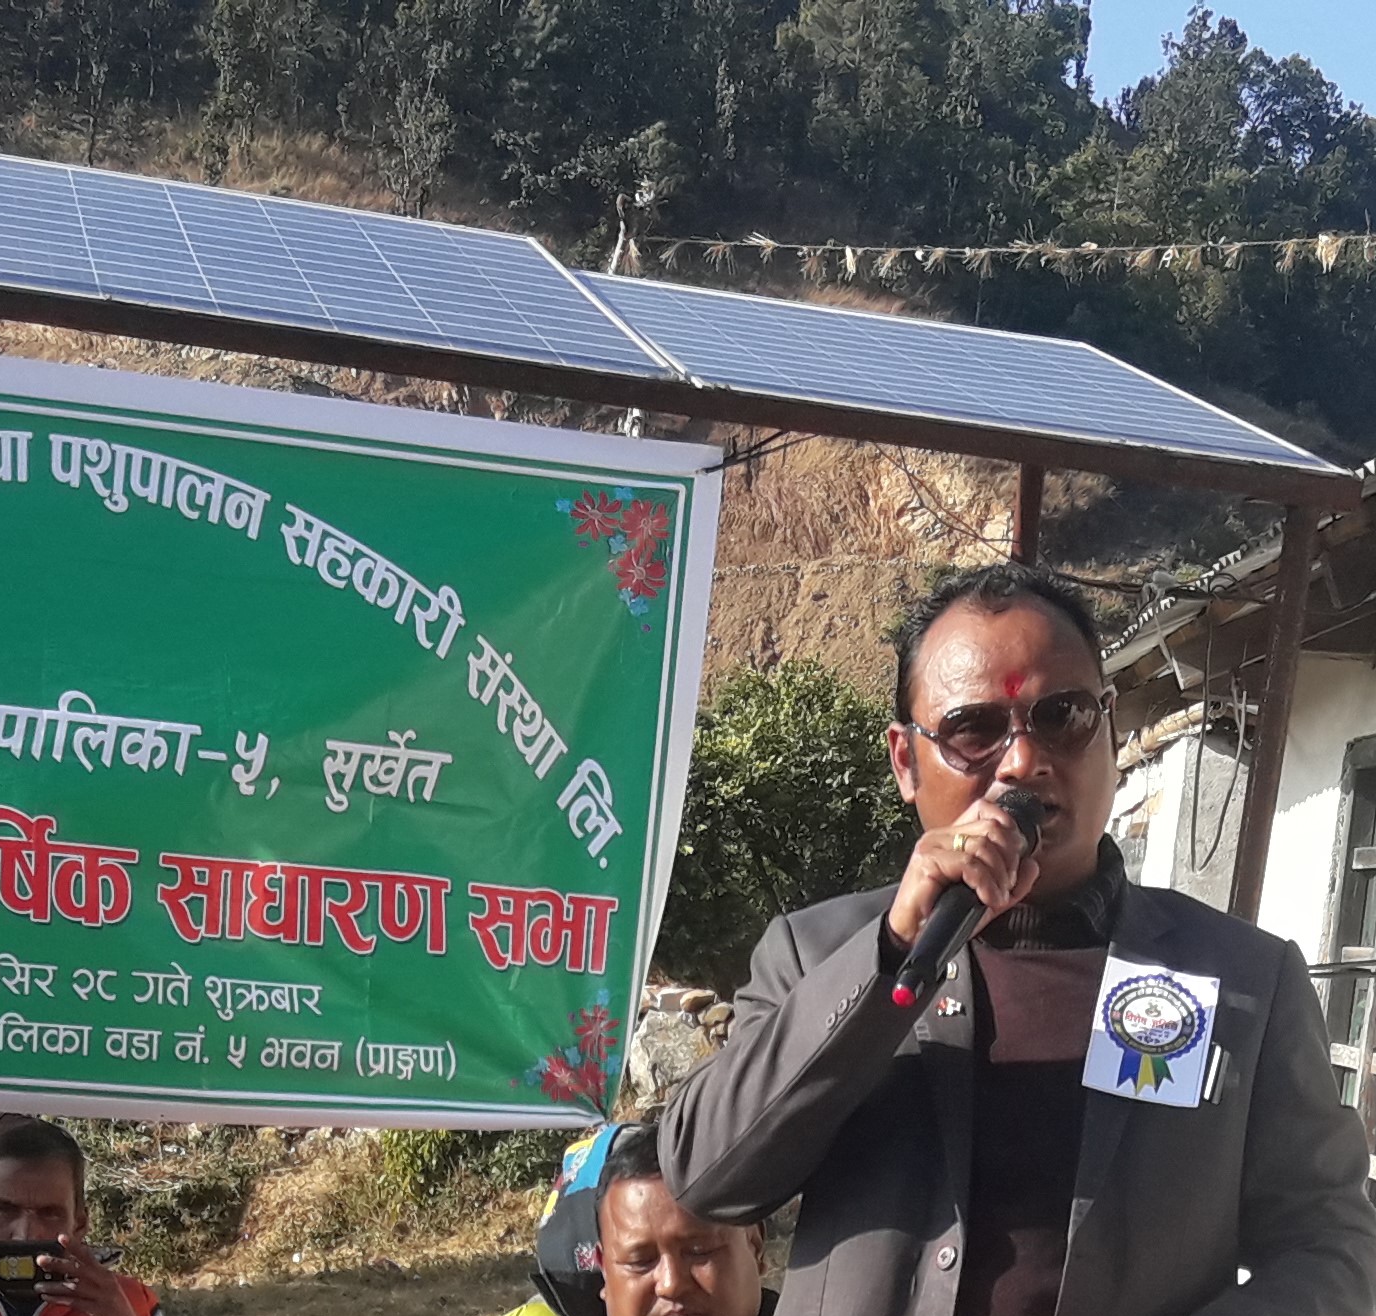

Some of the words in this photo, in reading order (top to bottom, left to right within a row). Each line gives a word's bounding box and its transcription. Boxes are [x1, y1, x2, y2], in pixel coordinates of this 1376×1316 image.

[48, 433, 272, 540] पशुपालन
[280, 503, 466, 660] सहकारी
[467, 634, 569, 780] संस्था
[556, 758, 623, 870] लि.
[323, 729, 453, 813] सुर्खेत
[156, 852, 452, 955] साधारण
[467, 881, 619, 975] सभा
[72, 967, 117, 1001] २८
[131, 961, 193, 1006] गते
[204, 975, 323, 1021] शुक्रबार
[104, 1026, 163, 1061] वडा
[227, 1035, 247, 1069] ५
[260, 1037, 343, 1071] भवन
